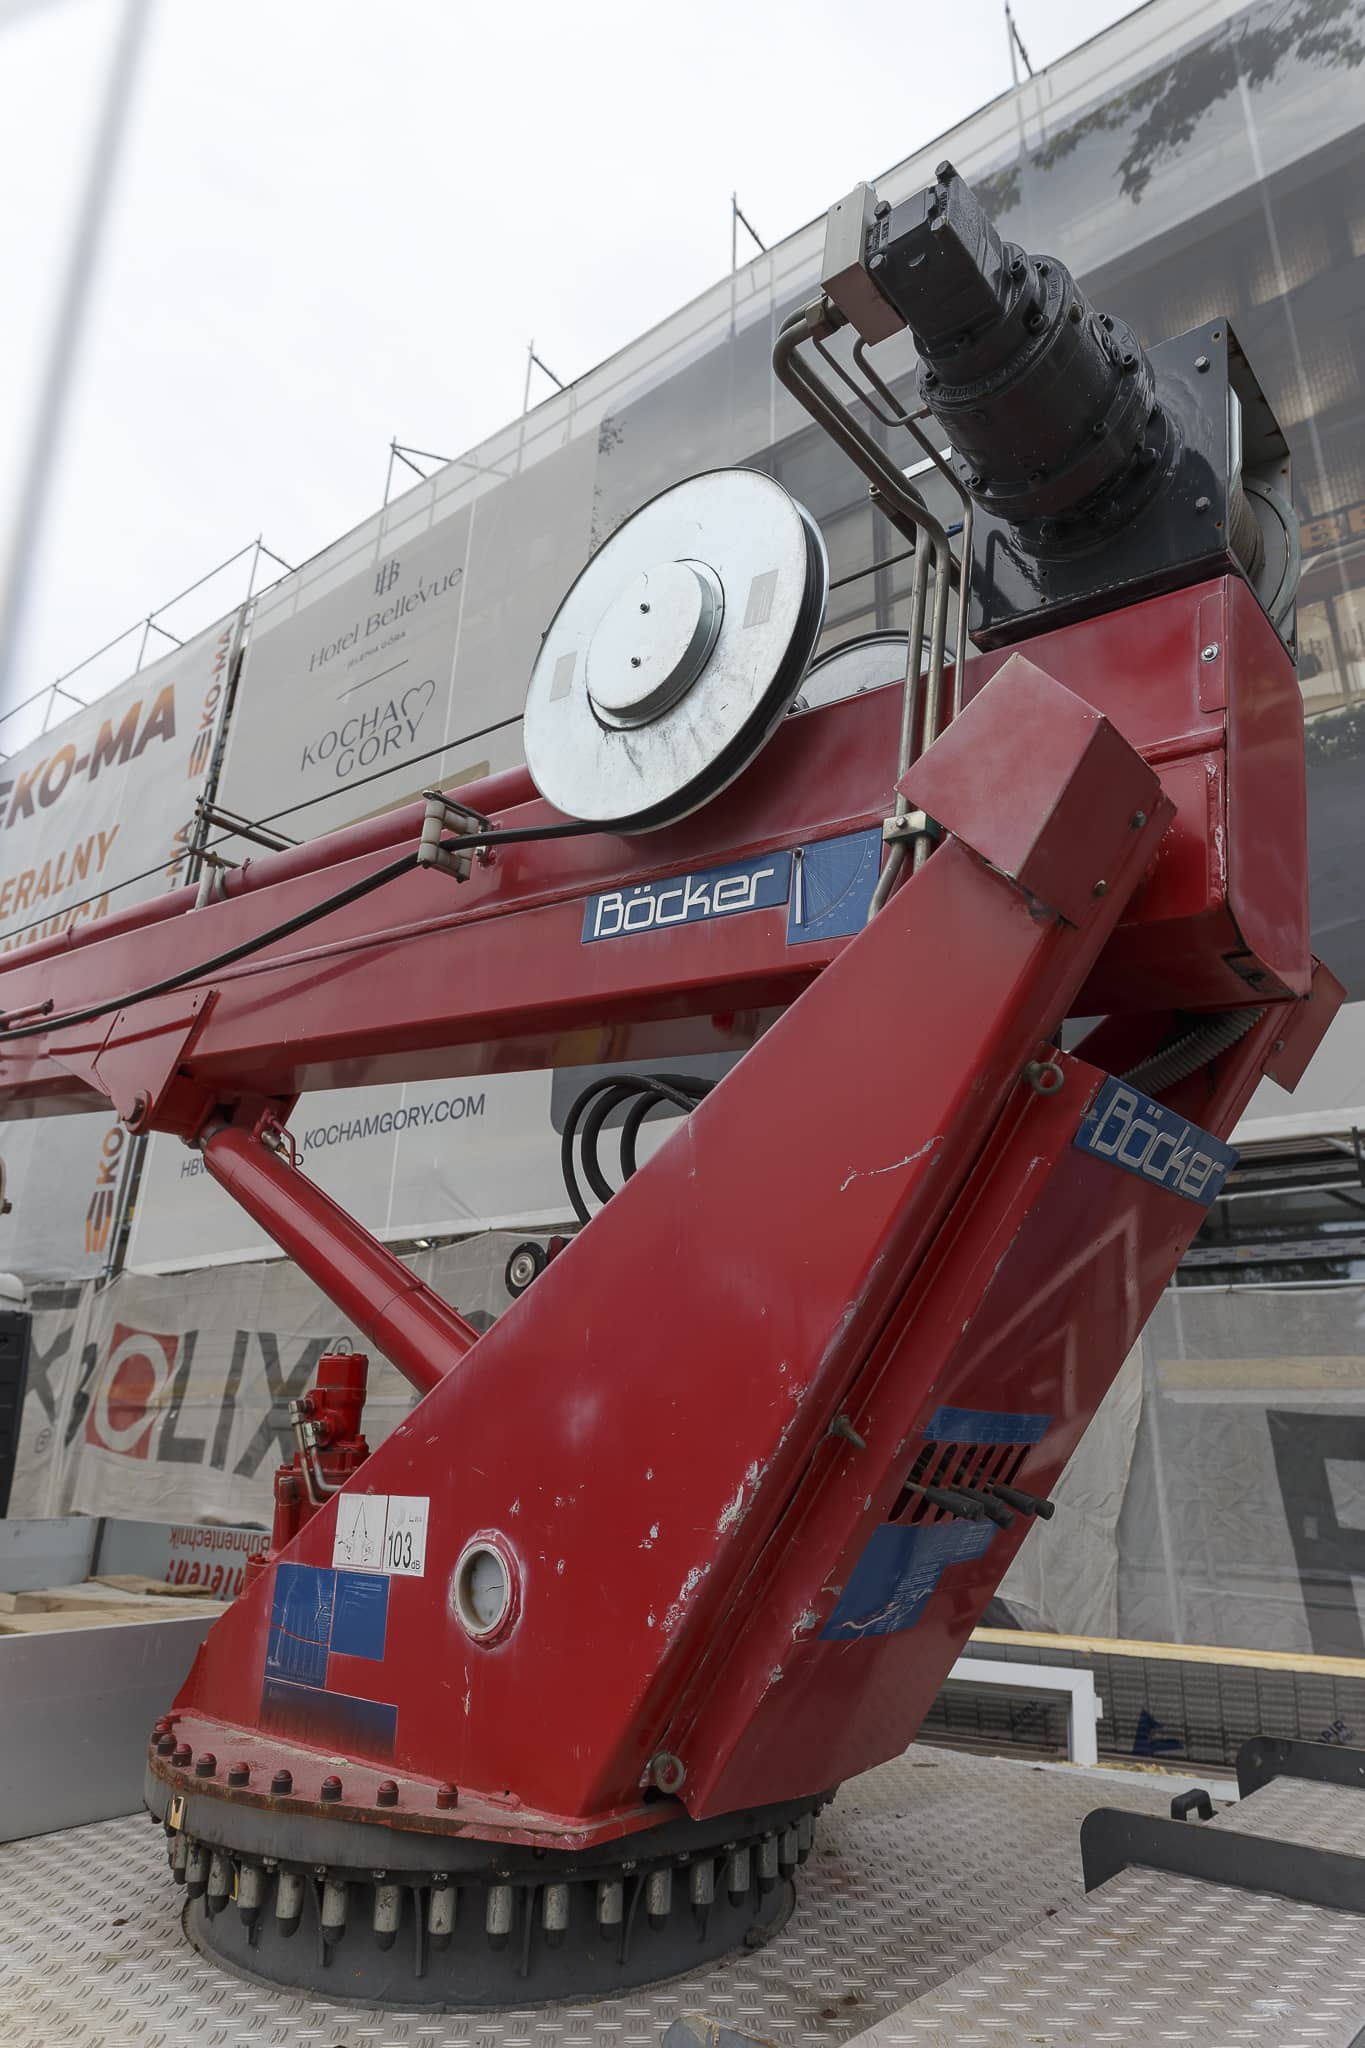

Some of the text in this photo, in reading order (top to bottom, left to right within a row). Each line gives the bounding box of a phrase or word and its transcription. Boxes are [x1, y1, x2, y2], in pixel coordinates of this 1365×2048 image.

[308, 567, 464, 672] Hotel Bellevue
[335, 711, 425, 778] GÓRY
[593, 868, 774, 937] Böcker
[303, 1094, 485, 1151] KOCHAMGORY.COM
[1089, 1087, 1225, 1197] Böcker
[387, 1530, 412, 1568] 103
